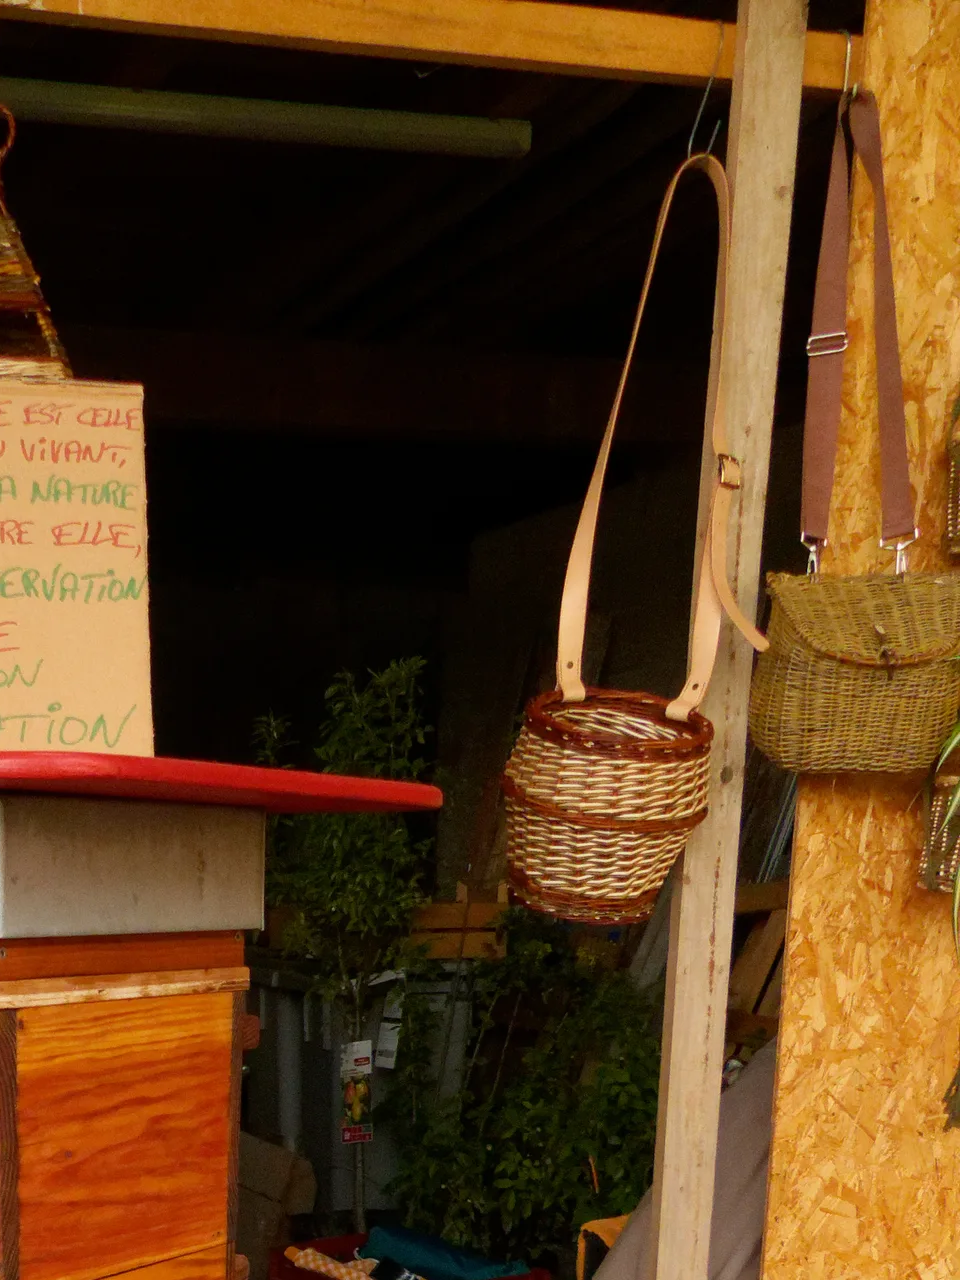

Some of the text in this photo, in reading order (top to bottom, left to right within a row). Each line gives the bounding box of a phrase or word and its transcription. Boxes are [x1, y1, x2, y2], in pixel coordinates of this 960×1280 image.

[23, 402, 77, 426] EST
[76, 407, 142, 432] CELLE
[29, 473, 140, 511] NATURE
[51, 520, 142, 559] ELLE,
